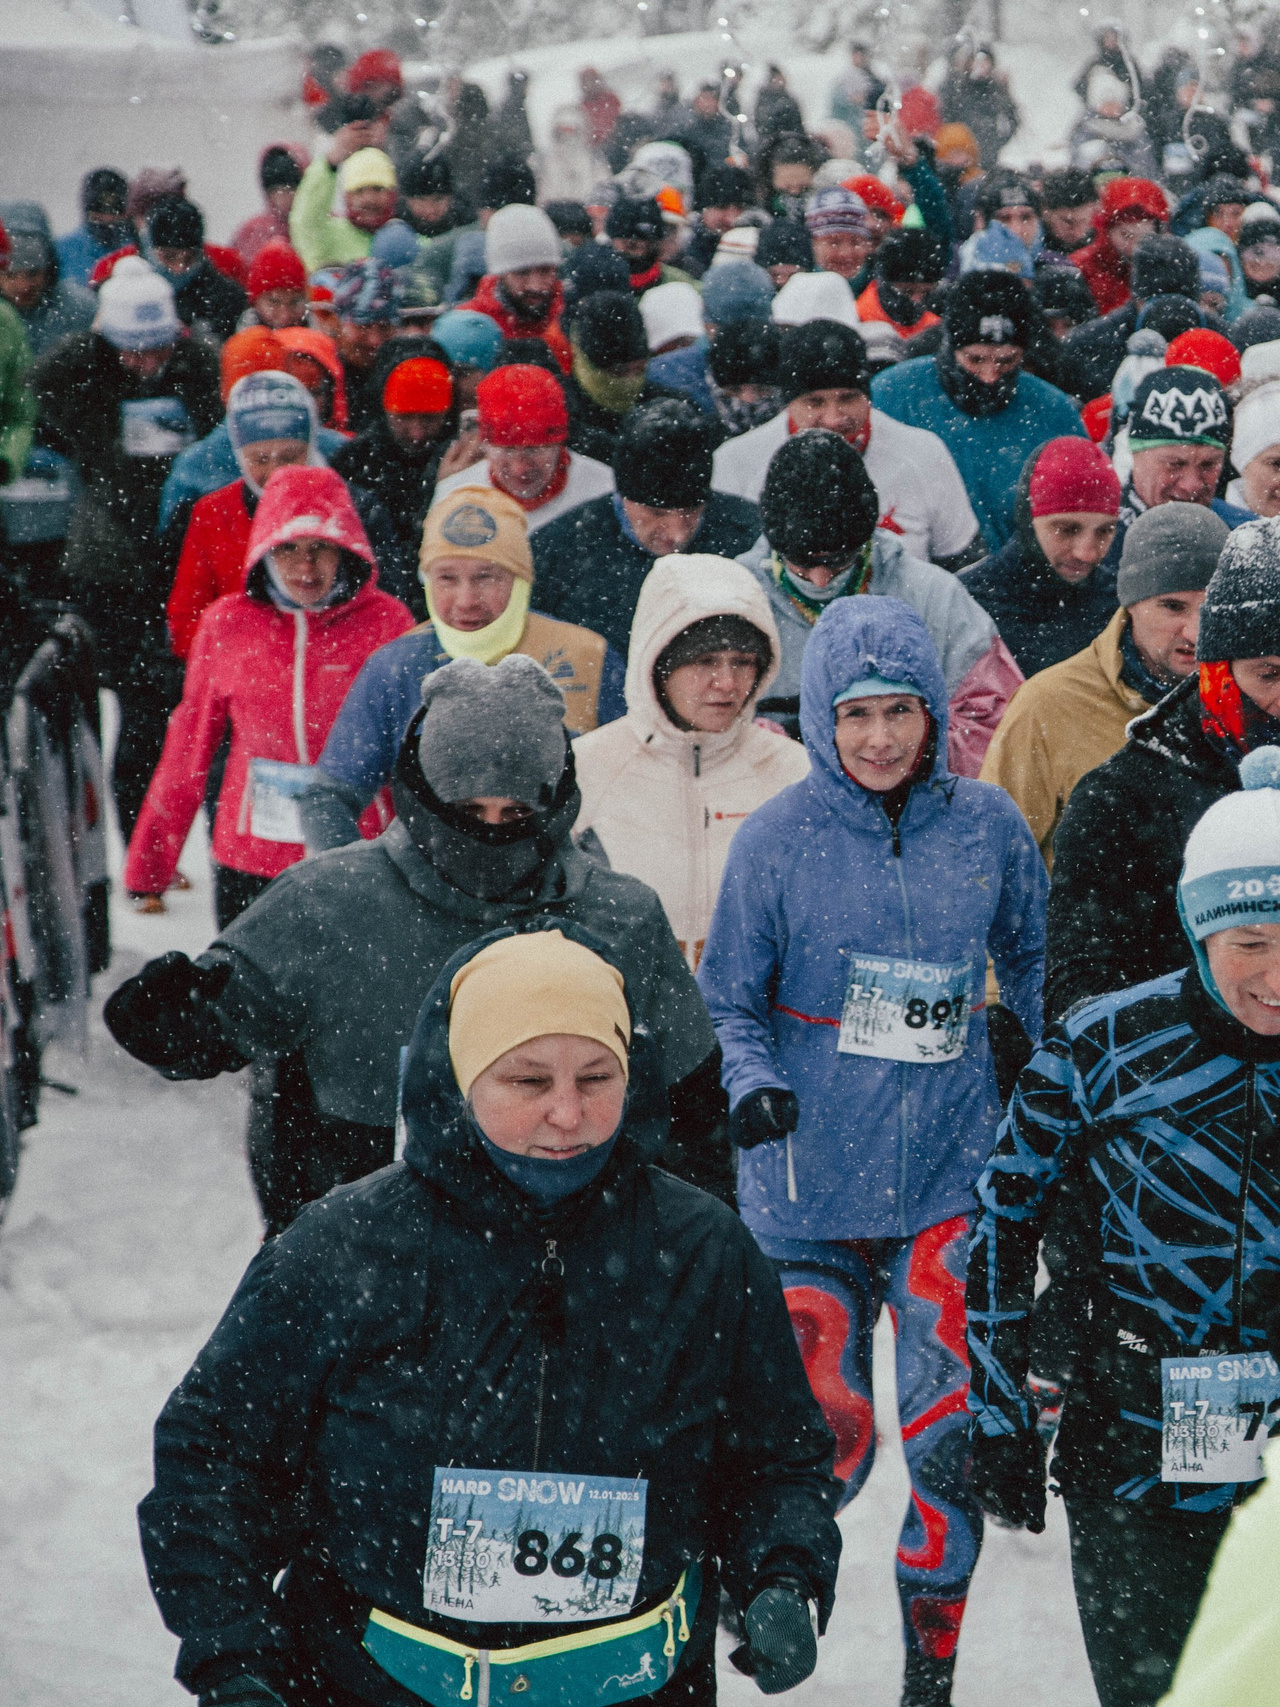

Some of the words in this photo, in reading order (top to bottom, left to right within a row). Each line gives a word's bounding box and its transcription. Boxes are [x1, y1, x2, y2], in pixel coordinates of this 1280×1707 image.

[855, 959, 890, 973] HARD
[893, 962, 953, 983] SNOW
[1117, 1328, 1137, 1341] RUN
[1128, 1343, 1148, 1354] LAB
[1169, 1366, 1213, 1381] HARD
[1171, 1425, 1219, 1438] 13:30
[1171, 1462, 1204, 1473] АННА
[440, 1478, 491, 1496] HARD
[497, 1477, 586, 1505] SNOW
[435, 1551, 490, 1569] 13:30
[514, 1529, 623, 1580] 868
[431, 1592, 474, 1610] ЕЛЕНА
